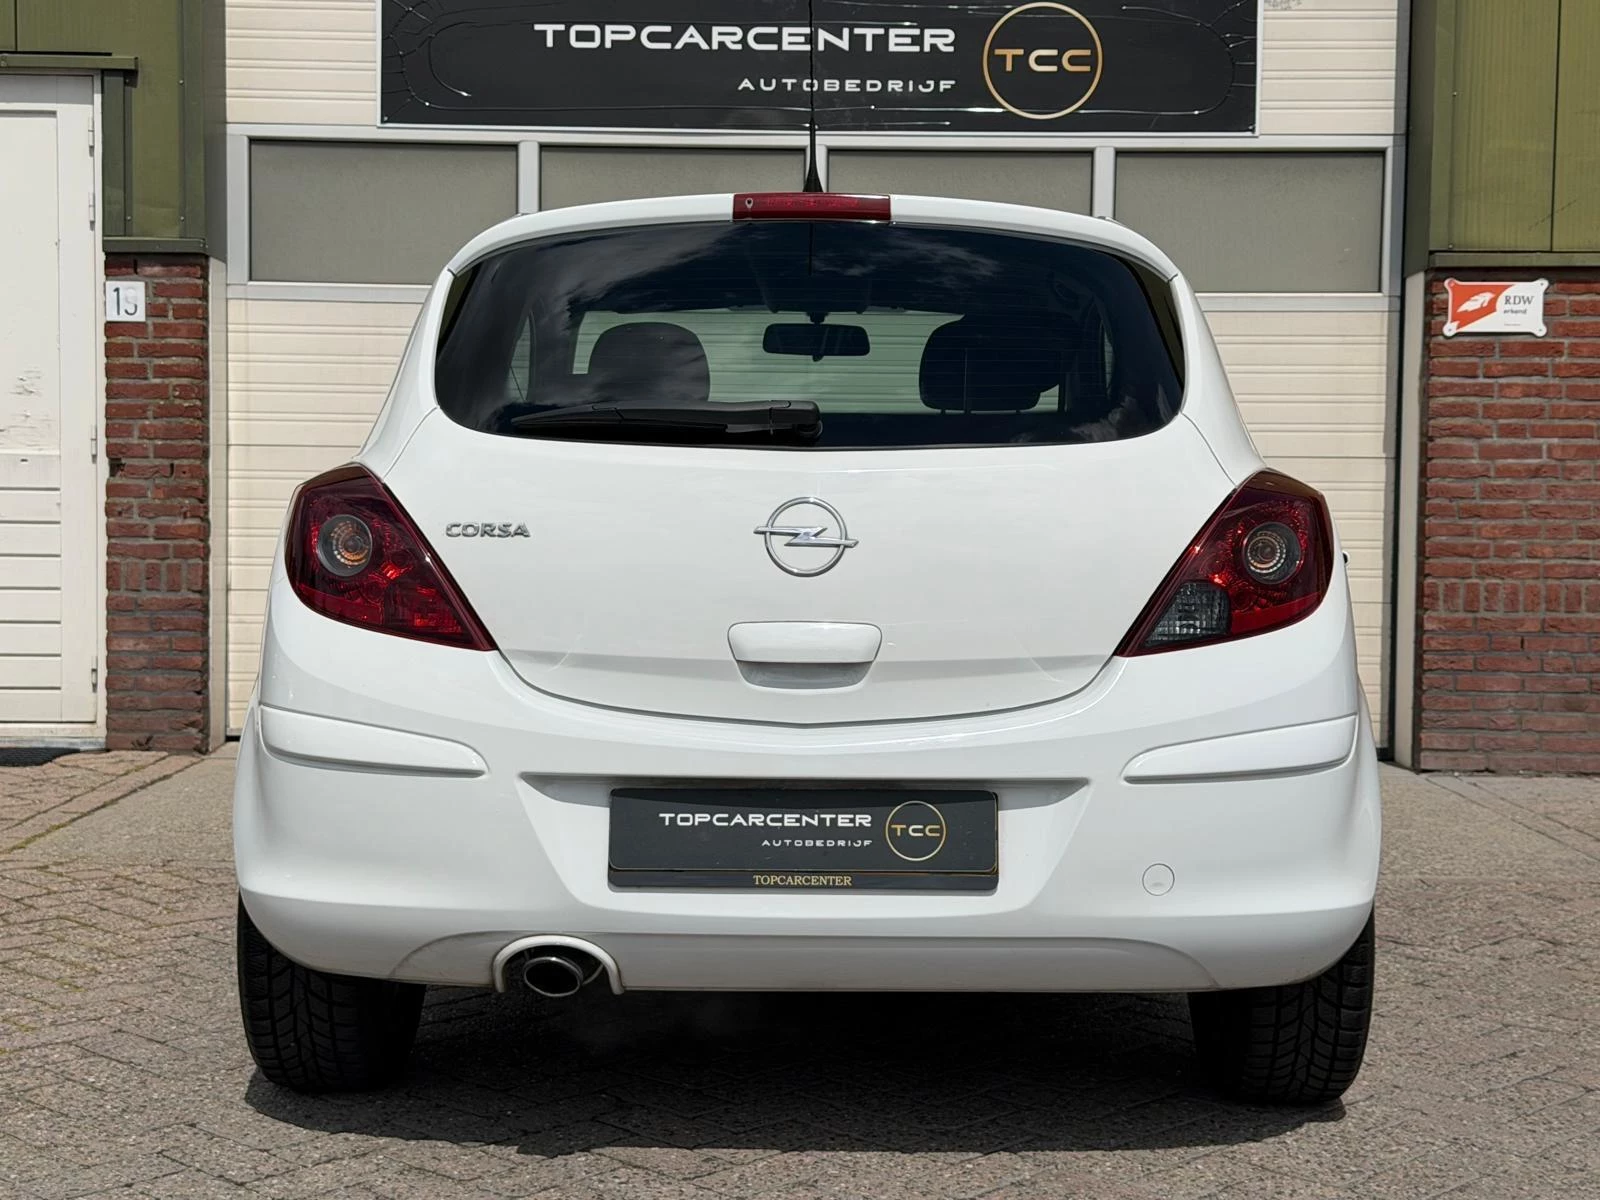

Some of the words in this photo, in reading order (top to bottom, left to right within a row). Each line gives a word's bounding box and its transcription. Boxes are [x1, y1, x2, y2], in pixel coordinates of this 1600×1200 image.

[533, 24, 956, 53] TOPCARCENTER
[994, 48, 1091, 72] TCC
[737, 78, 956, 93] AUTOBEDRIJF
[1504, 295, 1535, 305] RDW
[445, 522, 531, 538] CORSA
[658, 813, 872, 828] TOPCARCENTER
[890, 824, 941, 837] TCC
[761, 839, 873, 848] AUTOBEDRIJF
[752, 875, 853, 887] TOPCARCENTER
